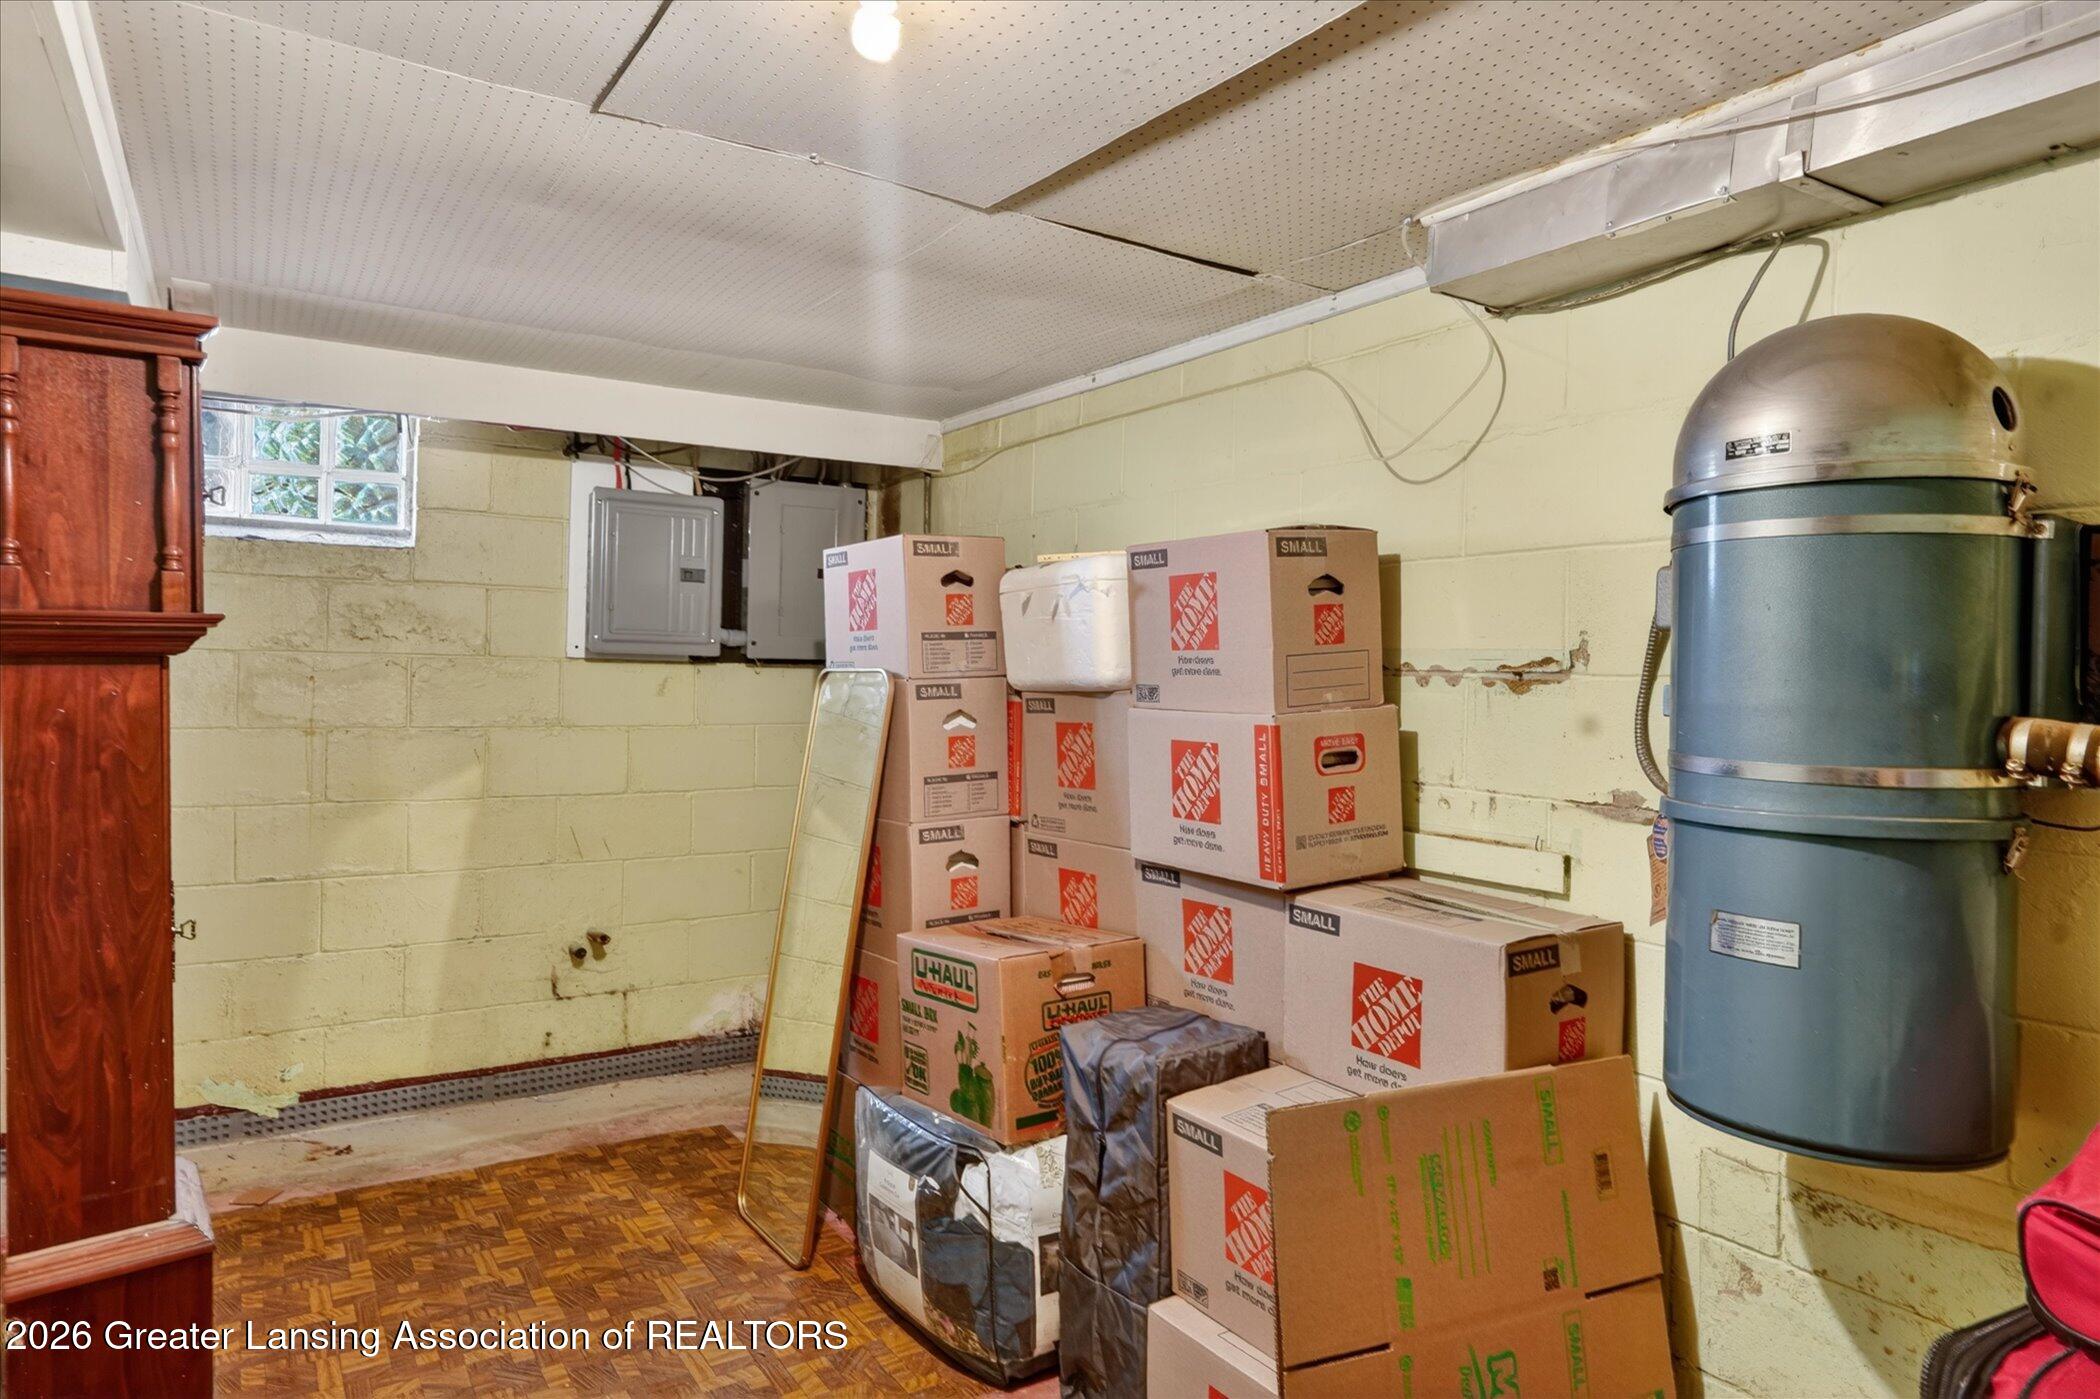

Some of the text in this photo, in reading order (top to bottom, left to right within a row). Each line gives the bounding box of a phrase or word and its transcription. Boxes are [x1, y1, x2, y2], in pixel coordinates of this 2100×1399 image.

[1133, 552, 1166, 568] SMALL
[1280, 540, 1323, 554] SMALL
[1171, 573, 1217, 650] HOME
[920, 685, 958, 698] SMALL
[1172, 742, 1219, 819] HOME
[1258, 732, 1272, 873] HEAVY DUTY SMALL
[922, 827, 962, 842] SMALL
[1292, 908, 1336, 932] SMALL
[1184, 905, 1232, 975] HOME
[915, 956, 974, 992] U-HAUL
[1512, 948, 1557, 973] SMALL
[1047, 997, 1107, 1019] U-HAUL
[1358, 976, 1388, 1008] THE
[1351, 974, 1423, 1051] HOME
[1378, 1010, 1422, 1058] DEPOT
[1346, 1065, 1362, 1079] get
[1364, 1072, 1389, 1087] more
[1356, 1054, 1407, 1082] How doers
[1176, 1119, 1220, 1151] SMALL
[1230, 1191, 1258, 1223] THE
[1225, 1202, 1274, 1267] HOM
[1225, 1279, 1241, 1297] get
[1242, 1290, 1267, 1312] more
[1234, 1269, 1254, 1290] How
